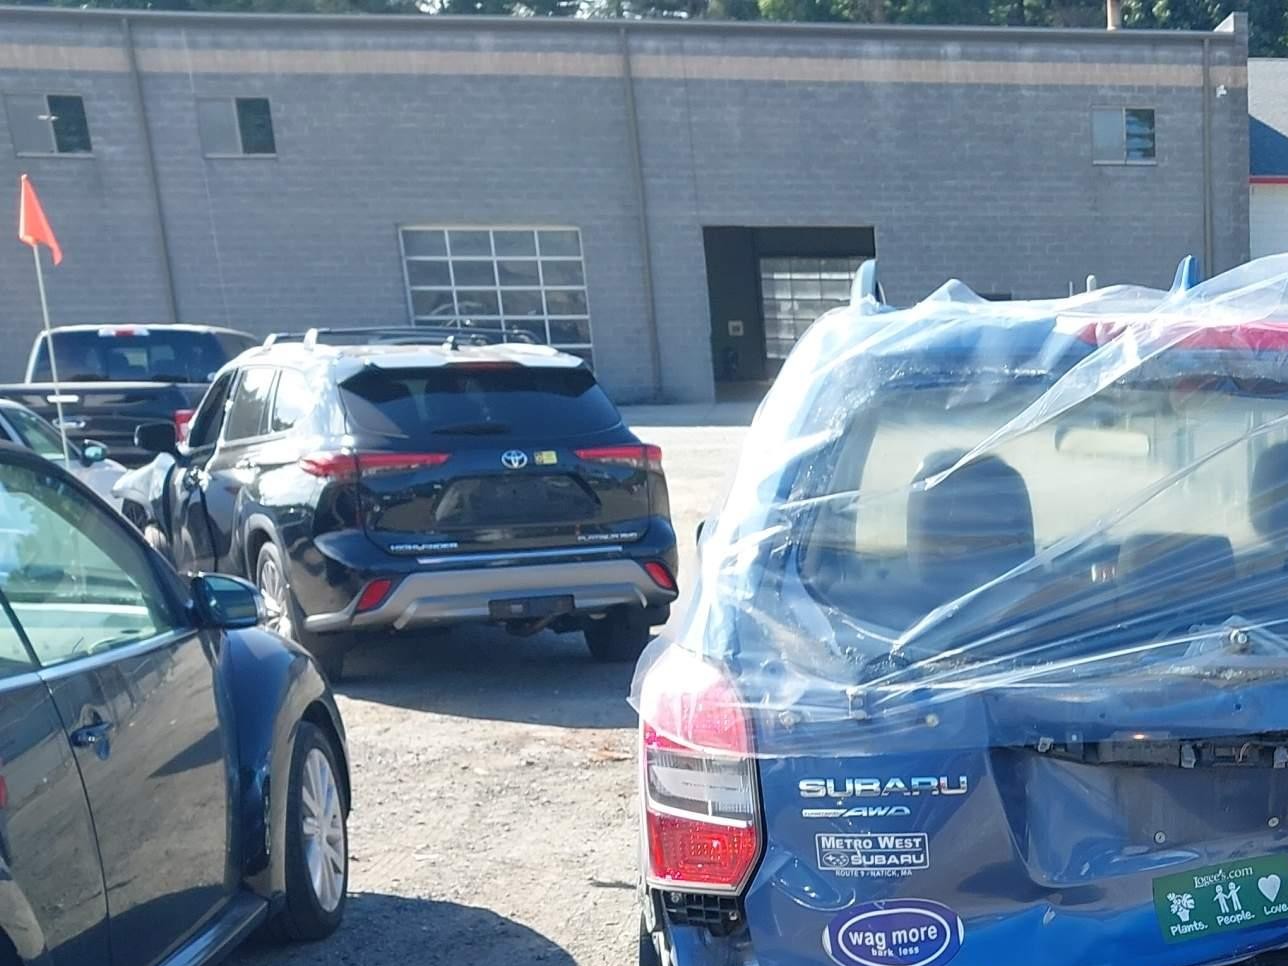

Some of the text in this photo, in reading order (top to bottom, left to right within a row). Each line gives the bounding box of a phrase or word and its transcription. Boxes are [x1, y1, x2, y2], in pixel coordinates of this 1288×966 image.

[799, 776, 968, 798] SUBARU
[843, 806, 911, 818] AWD
[821, 835, 922, 849] METRO WEST
[851, 853, 925, 865] SUBARU
[835, 870, 858, 878] ROUTE
[1170, 921, 1208, 936] Plants.
[1216, 911, 1255, 926] People.
[849, 925, 938, 950] wag more
[871, 945, 919, 957] bark less
